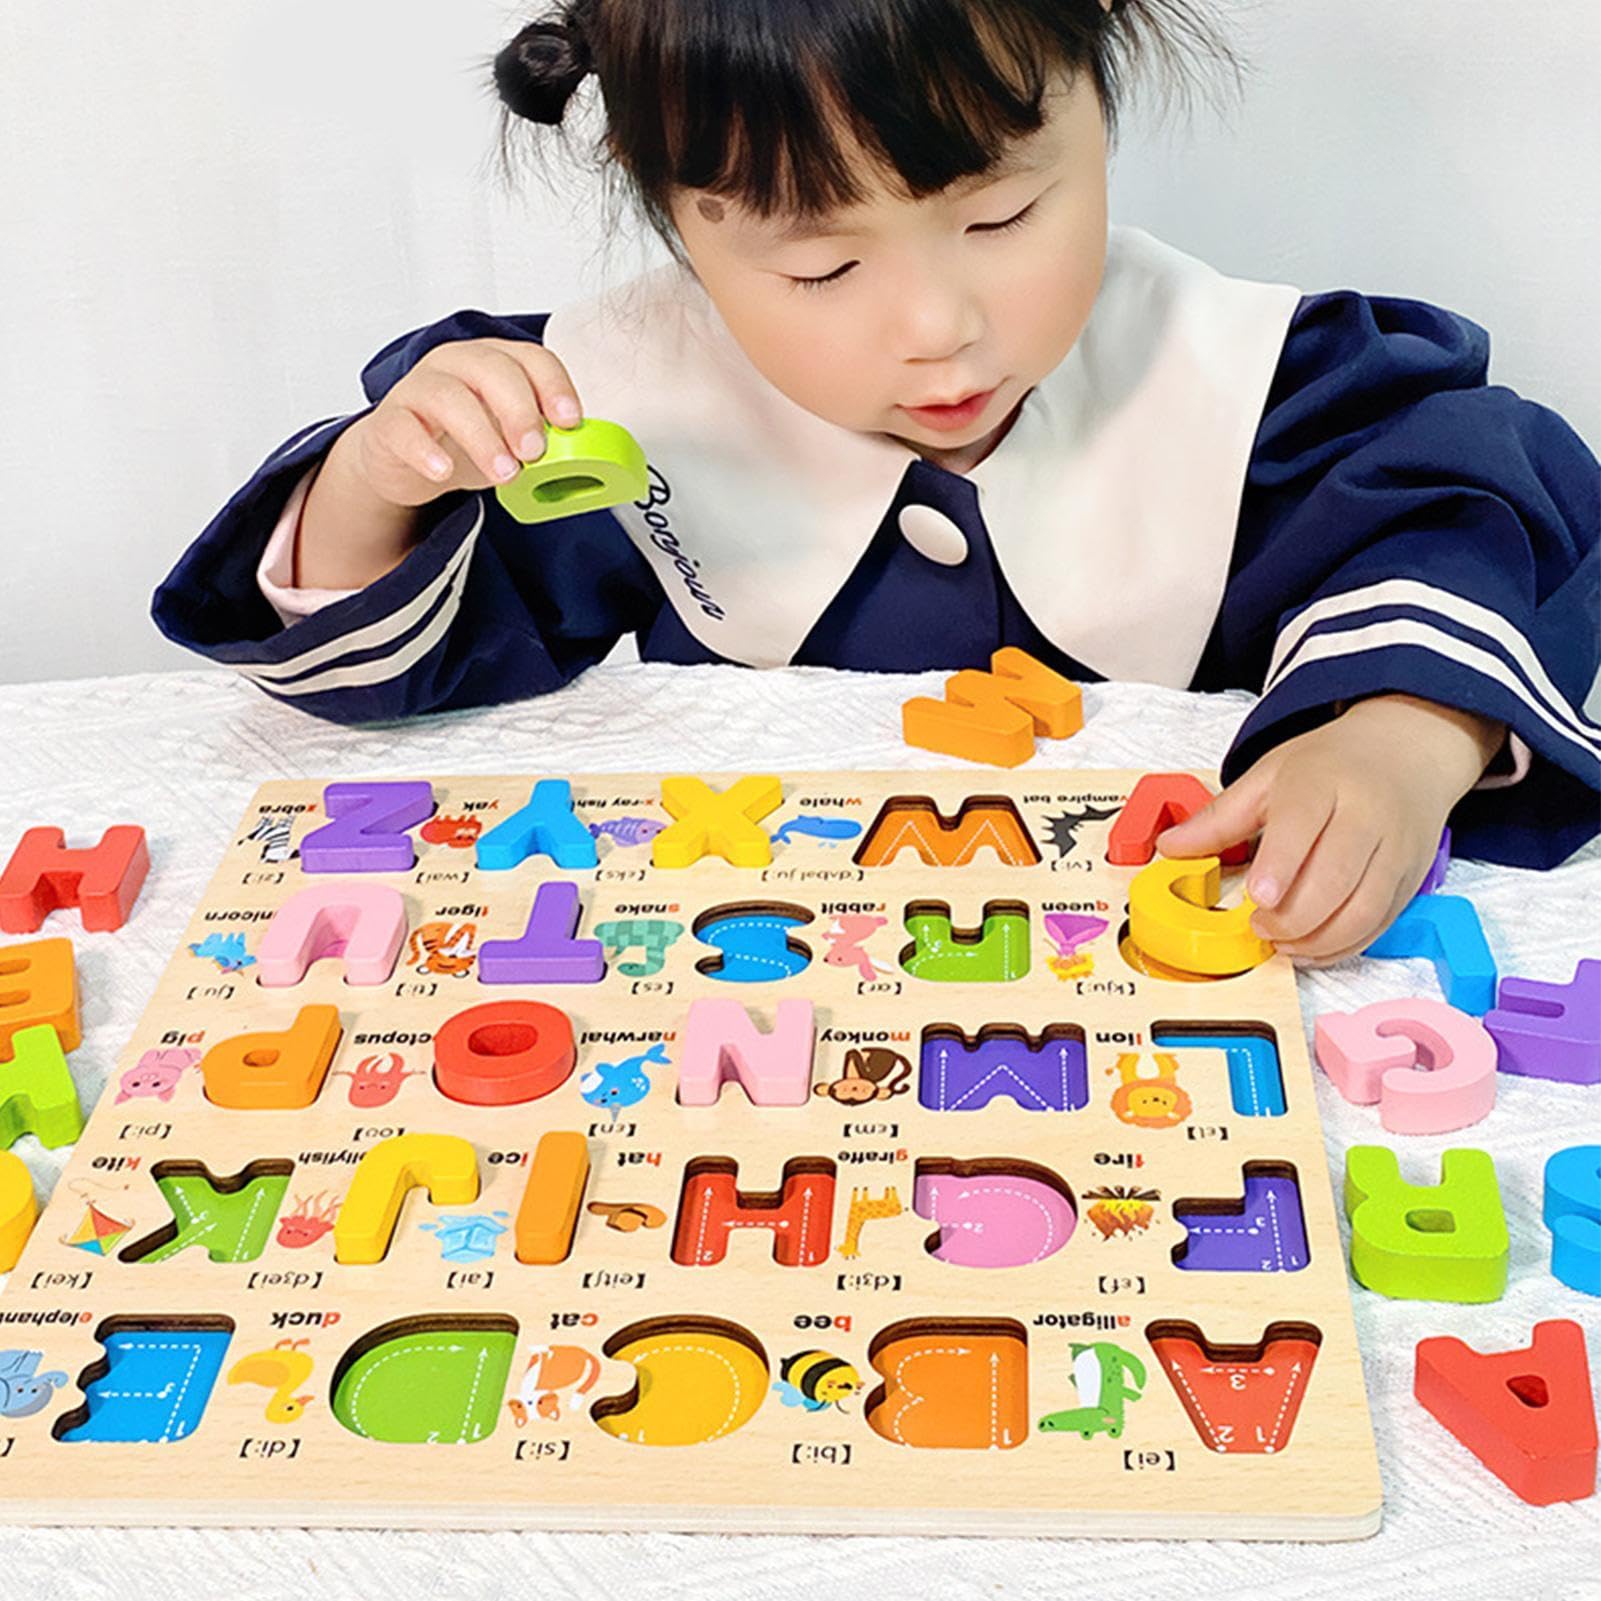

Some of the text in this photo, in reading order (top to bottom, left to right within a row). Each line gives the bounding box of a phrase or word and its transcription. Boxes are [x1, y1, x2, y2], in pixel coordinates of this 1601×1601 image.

[461, 797, 500, 813] yak
[799, 797, 863, 809] whale
[1023, 793, 1052, 805] bat
[257, 802, 317, 816] zebra
[435, 904, 489, 919] tiger
[614, 903, 680, 915] snake
[820, 901, 887, 915] rabbit
[1040, 899, 1109, 914] queen
[205, 910, 273, 923] nicorn
[160, 1030, 206, 1047] pig
[353, 1031, 432, 1047] ctopus
[580, 1031, 677, 1045] narwhal
[820, 1029, 912, 1045] monkey
[1095, 1032, 1142, 1046] lion
[91, 1155, 142, 1172] kite
[298, 1150, 366, 1166] llyfish
[487, 1152, 529, 1167] ice
[616, 1151, 663, 1168] hat
[837, 1149, 909, 1166] giraffe
[1093, 1152, 1146, 1169] fire
[270, 1311, 341, 1329] duck
[550, 1312, 599, 1330] cat
[792, 1314, 853, 1333] bee
[1032, 1311, 1132, 1331] alligator
